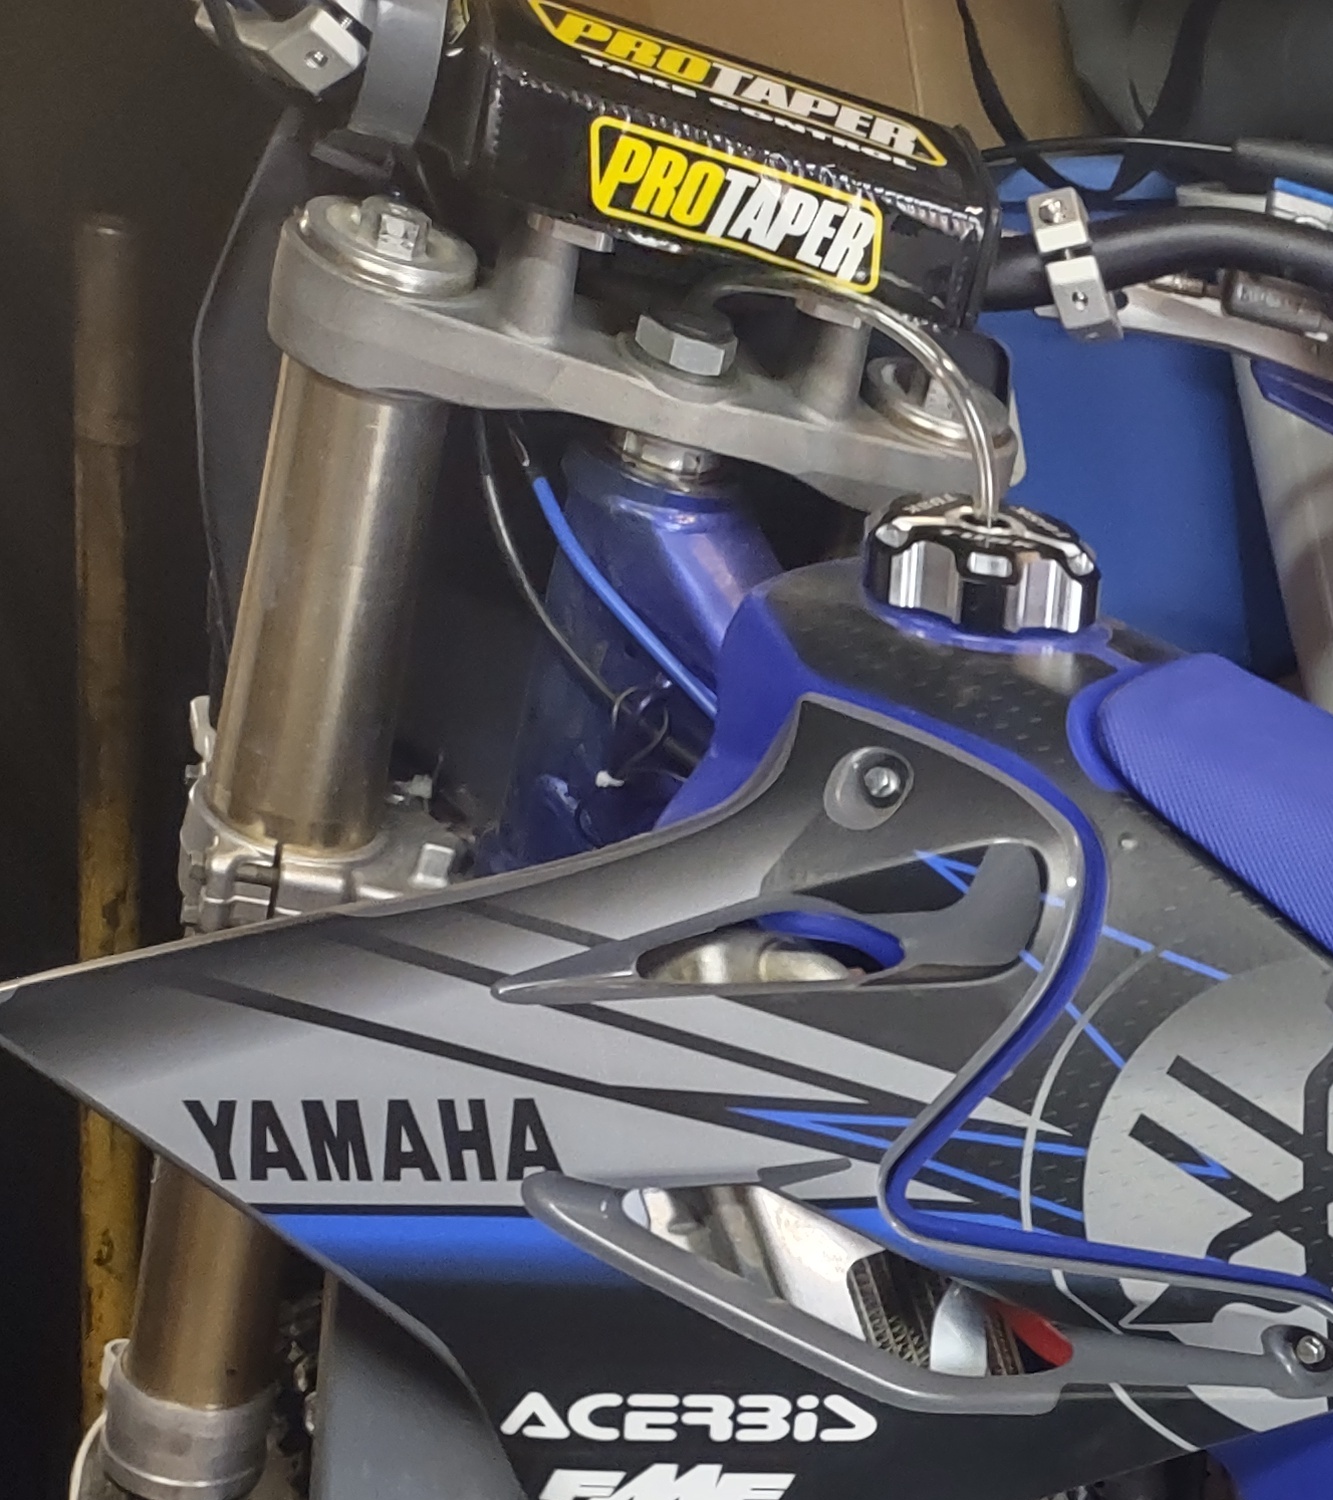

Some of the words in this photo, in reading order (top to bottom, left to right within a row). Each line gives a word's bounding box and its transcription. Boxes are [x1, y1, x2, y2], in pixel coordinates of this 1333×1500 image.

[556, 13, 918, 156] PROTAPER
[601, 134, 877, 283] PROTAPER
[183, 1097, 566, 1182] YAMAHA
